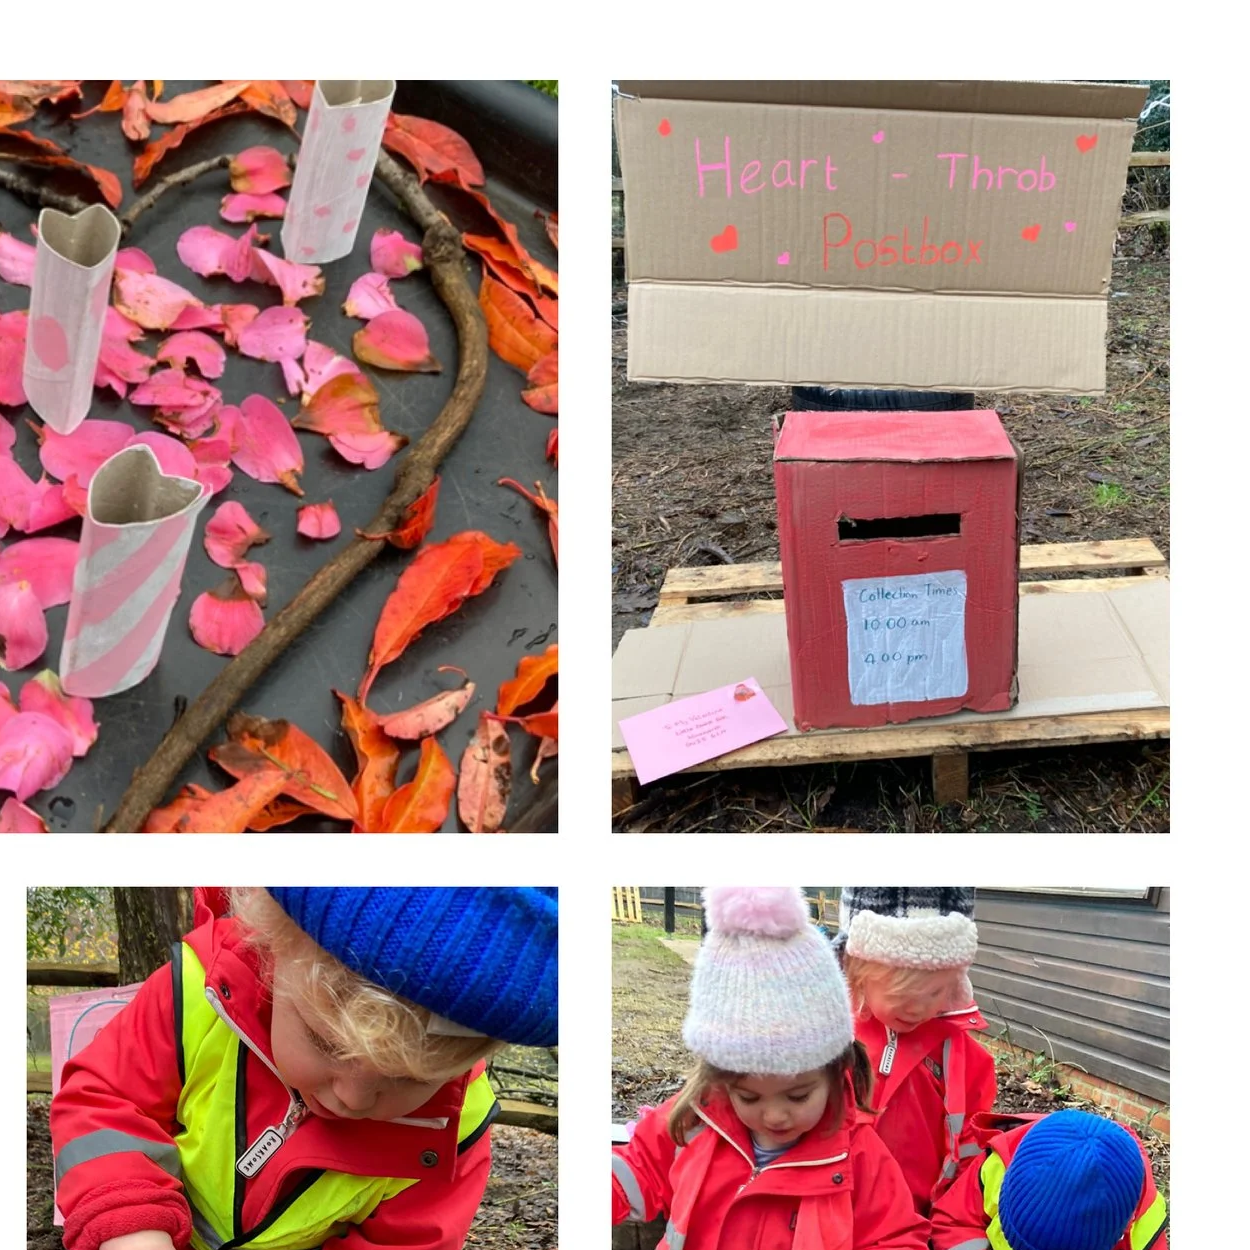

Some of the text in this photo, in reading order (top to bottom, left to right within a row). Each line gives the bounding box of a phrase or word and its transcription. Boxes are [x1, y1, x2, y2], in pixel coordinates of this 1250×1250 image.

[694, 136, 839, 198] Heart
[937, 151, 1057, 193] Throb
[822, 212, 985, 271] Postbox
[859, 587, 918, 603] Collection
[911, 619, 931, 628] am
[907, 653, 928, 665] pm
[242, 1135, 278, 1172] ROARSOME
